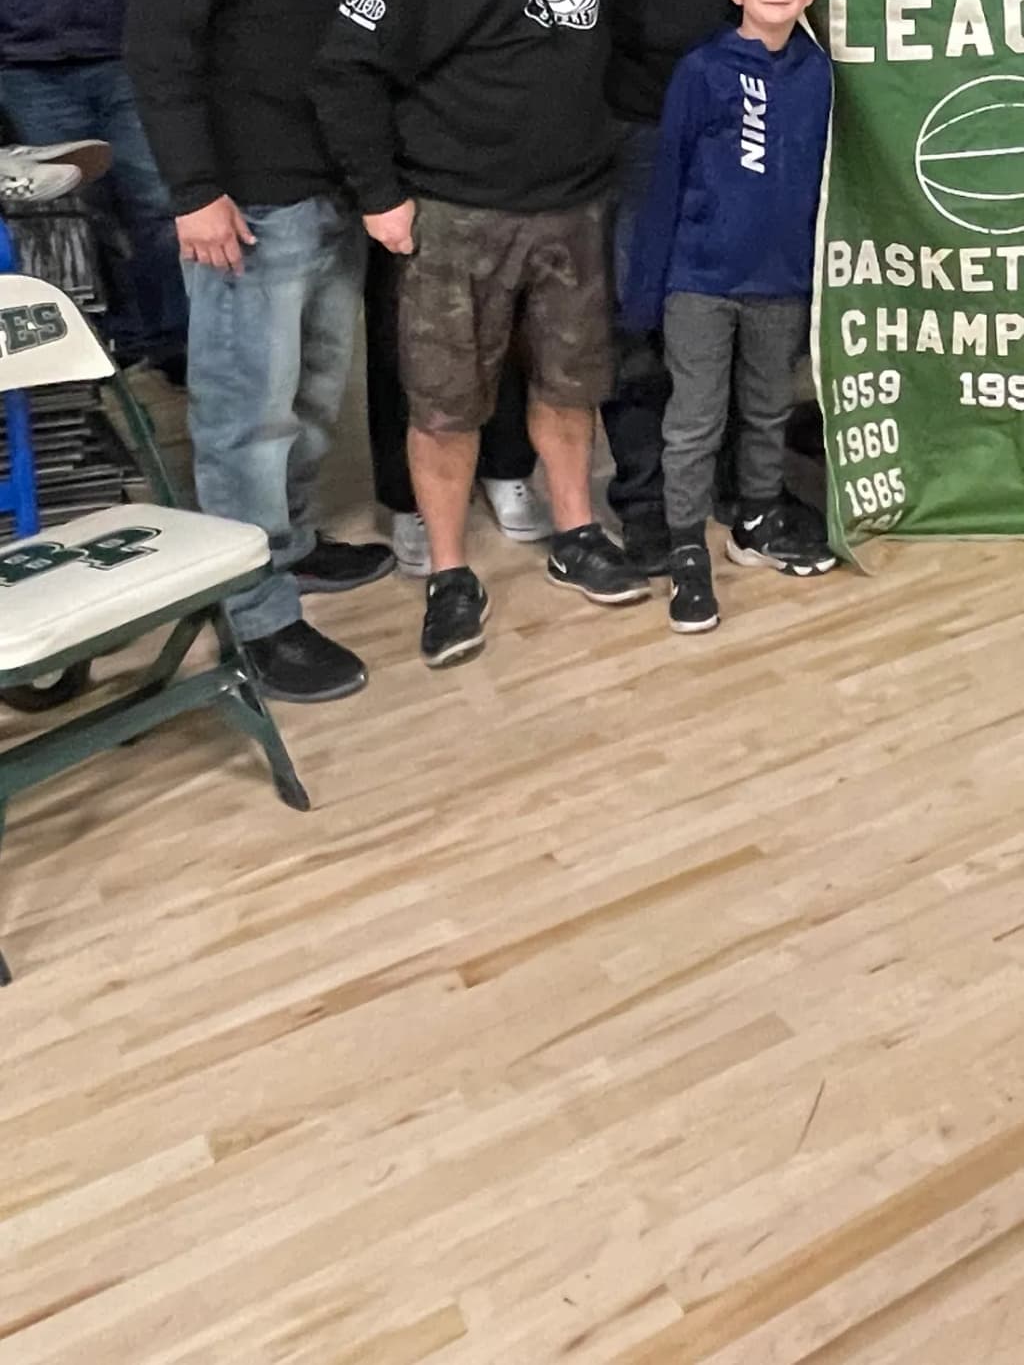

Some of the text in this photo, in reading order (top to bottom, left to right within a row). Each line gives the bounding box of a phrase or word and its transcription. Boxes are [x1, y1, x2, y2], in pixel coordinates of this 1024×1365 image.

[740, 73, 768, 174] NIKE
[0, 302, 68, 355] ES
[831, 369, 901, 414] 1959
[836, 418, 899, 466] 1960
[845, 467, 905, 517] 1985
